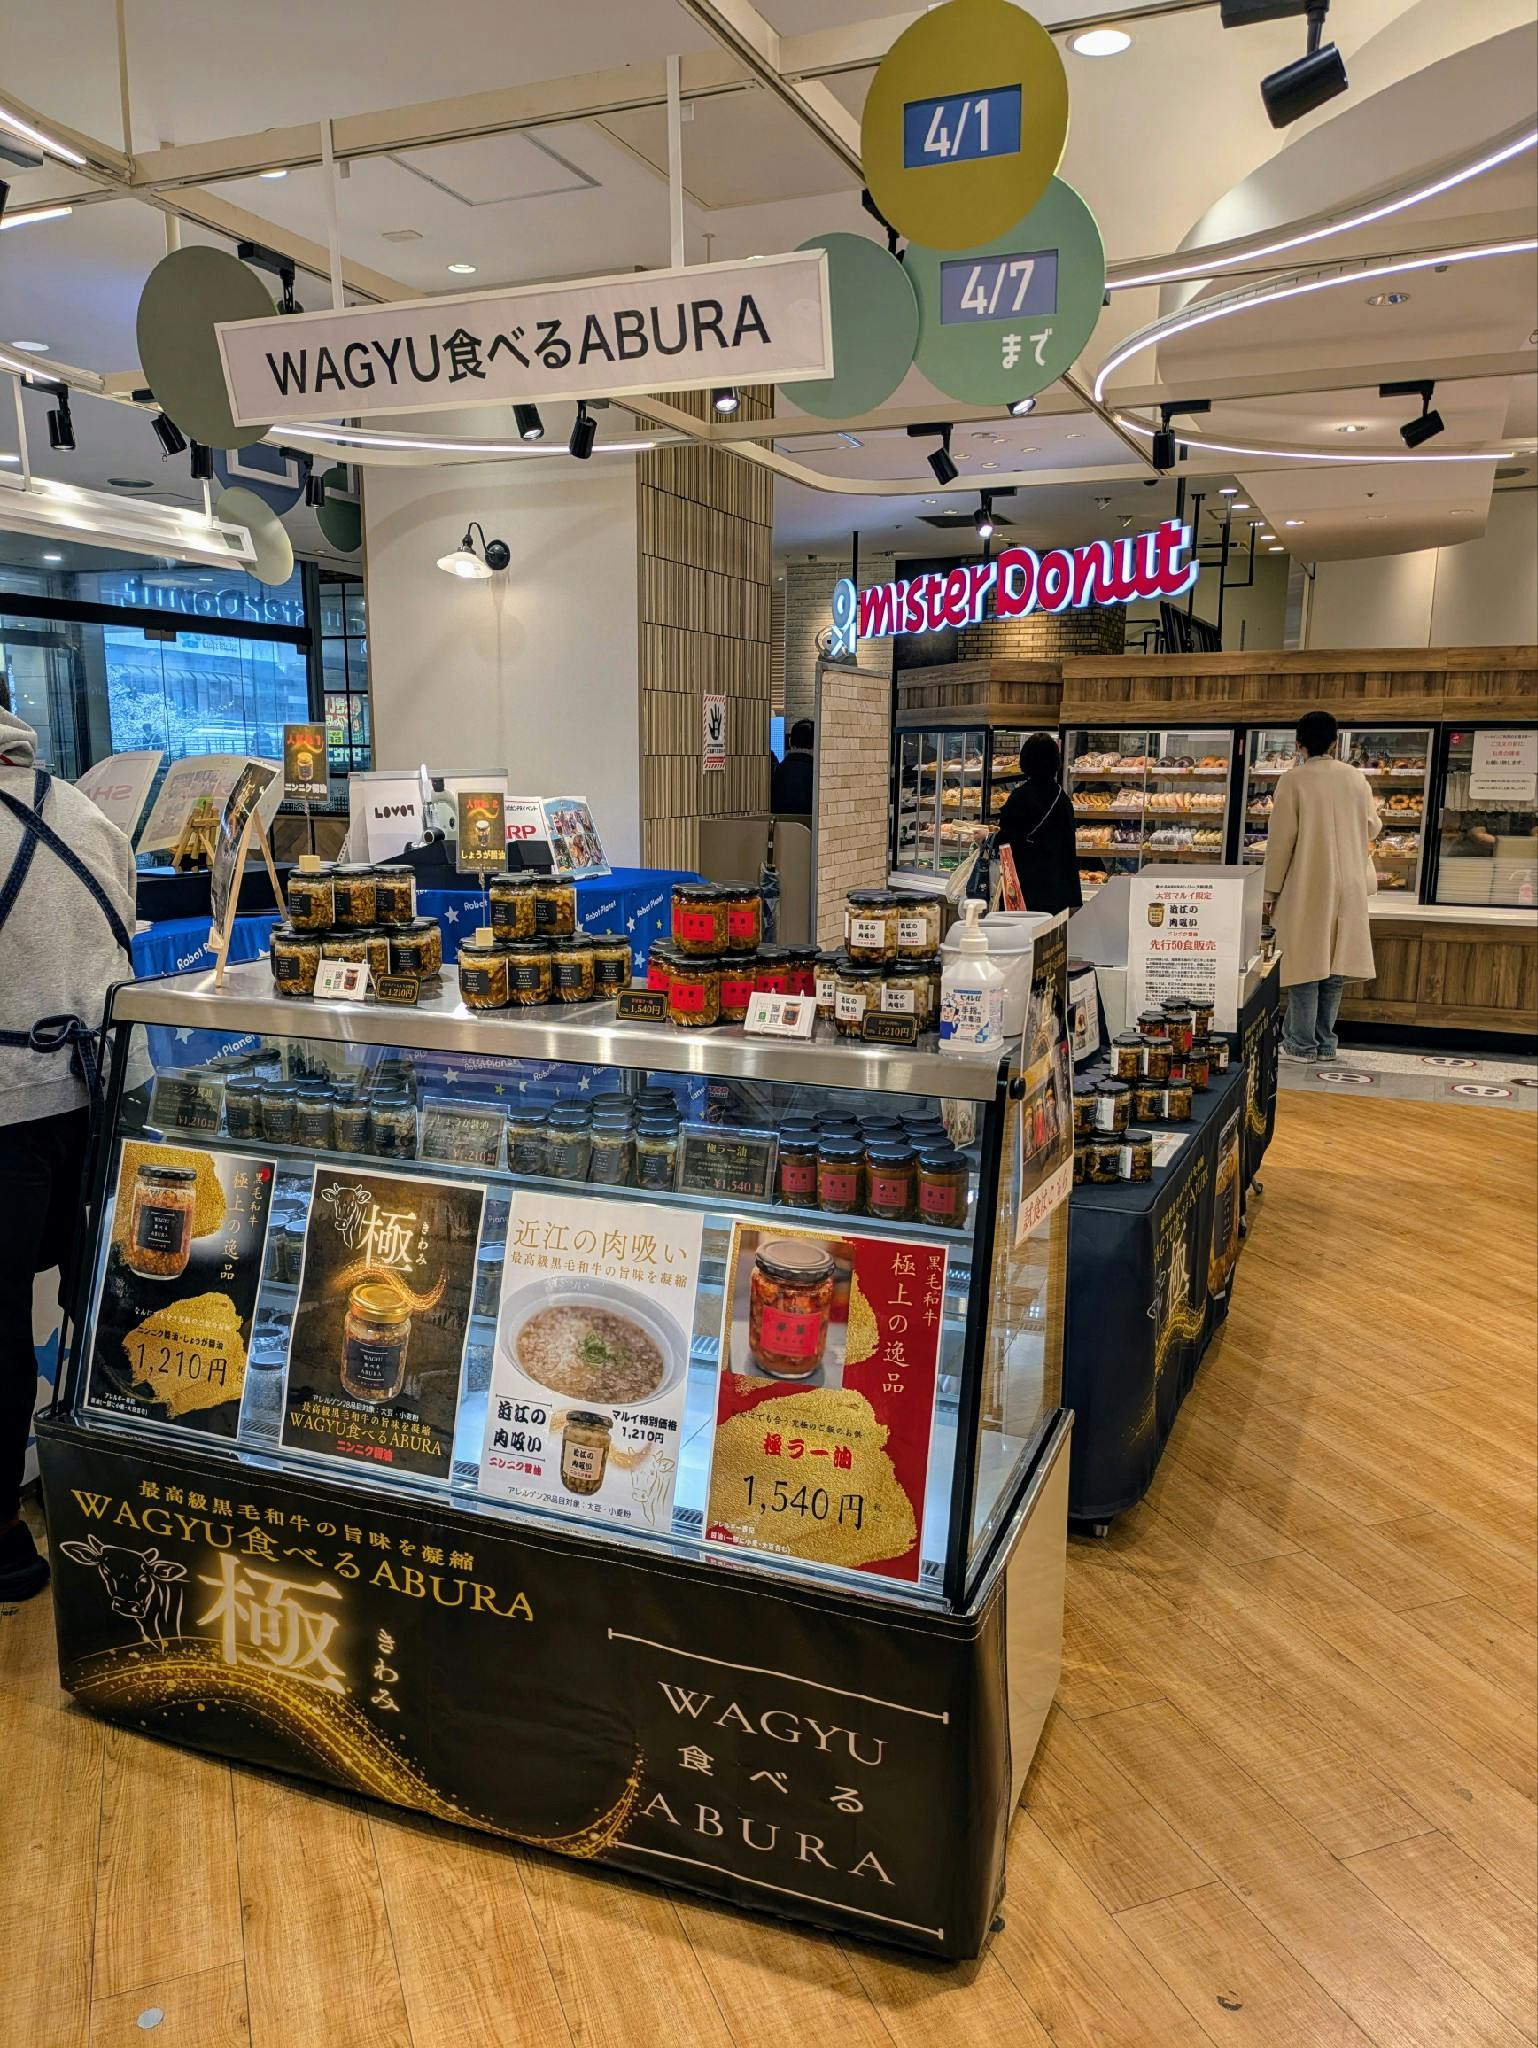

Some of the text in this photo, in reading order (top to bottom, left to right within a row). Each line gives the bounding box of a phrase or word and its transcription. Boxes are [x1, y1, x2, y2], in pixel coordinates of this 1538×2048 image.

[924, 98, 989, 157] 4/1
[960, 259, 1035, 314] 4/7
[266, 294, 772, 396] WAGYU食べるABURA
[1001, 328, 1053, 369] まで
[996, 518, 1199, 618] Donut
[177, 947, 204, 970] Robot
[1150, 939, 1217, 951] 先行50食販売
[220, 1169, 249, 1280] 極上の逸品
[248, 1172, 264, 1230] 黒毛和牛
[359, 1205, 416, 1272] 極
[416, 1221, 430, 1265] きわみ
[512, 1218, 688, 1265] 近江の肉吸い
[510, 1251, 688, 1289] 最高級黒毛和牛の旨味を凝縮
[922, 1254, 943, 1327] 黒毛和牛
[882, 1251, 917, 1394] 極上の逸品
[136, 1343, 228, 1387] 1,210円
[493, 1428, 542, 1452] 肉吸い
[497, 1400, 547, 1425] 近江の
[611, 1409, 678, 1432] マルイ特別価格
[621, 1426, 664, 1444] 1,210円
[763, 1431, 853, 1470] 極ラー油
[139, 1479, 475, 1572] 最高級黒毛和牛の旨味を凝縮
[743, 1475, 864, 1531] 1,540円
[196, 1552, 346, 1696] 極
[371, 1628, 401, 1713] きわみ
[657, 1680, 889, 1767] WAGYU
[677, 1744, 865, 1814] 食べる
[641, 1792, 897, 1887] ABURA
